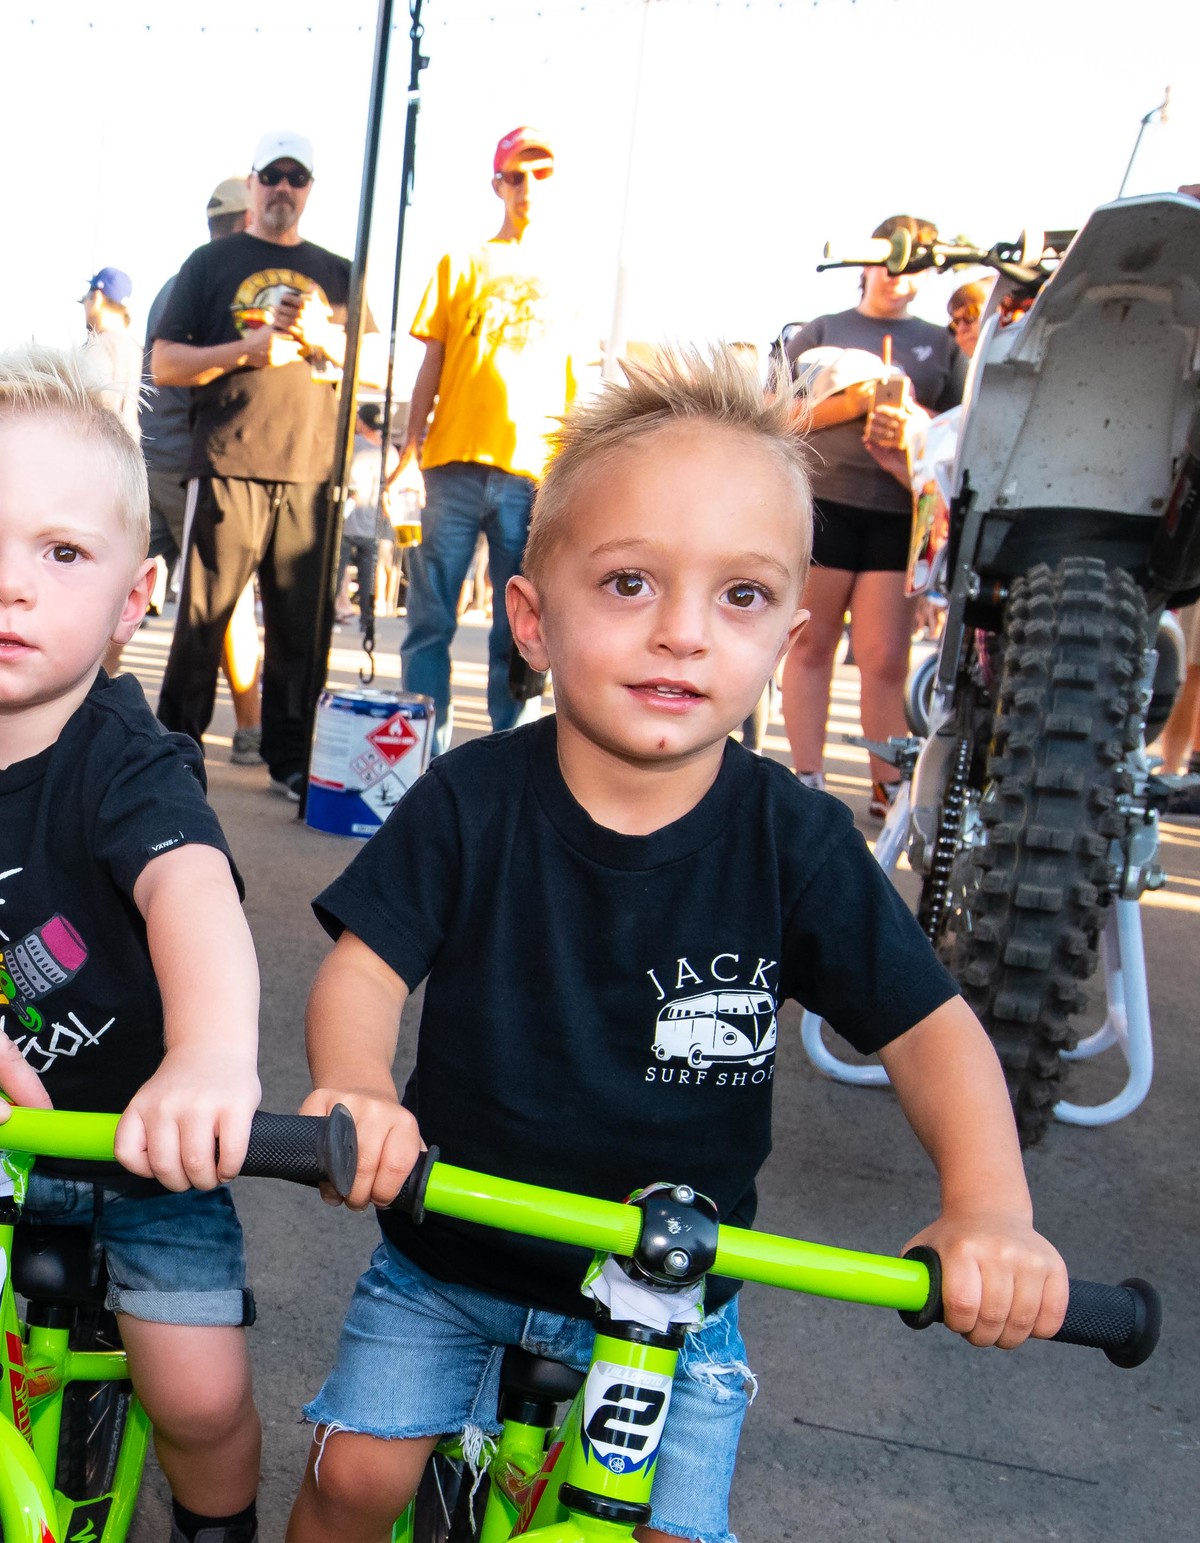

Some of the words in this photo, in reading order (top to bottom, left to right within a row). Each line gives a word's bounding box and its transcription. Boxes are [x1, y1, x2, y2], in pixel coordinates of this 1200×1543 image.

[647, 953, 778, 1000] JACK
[645, 1067, 707, 1085] SURF
[586, 1383, 666, 1451] 2
